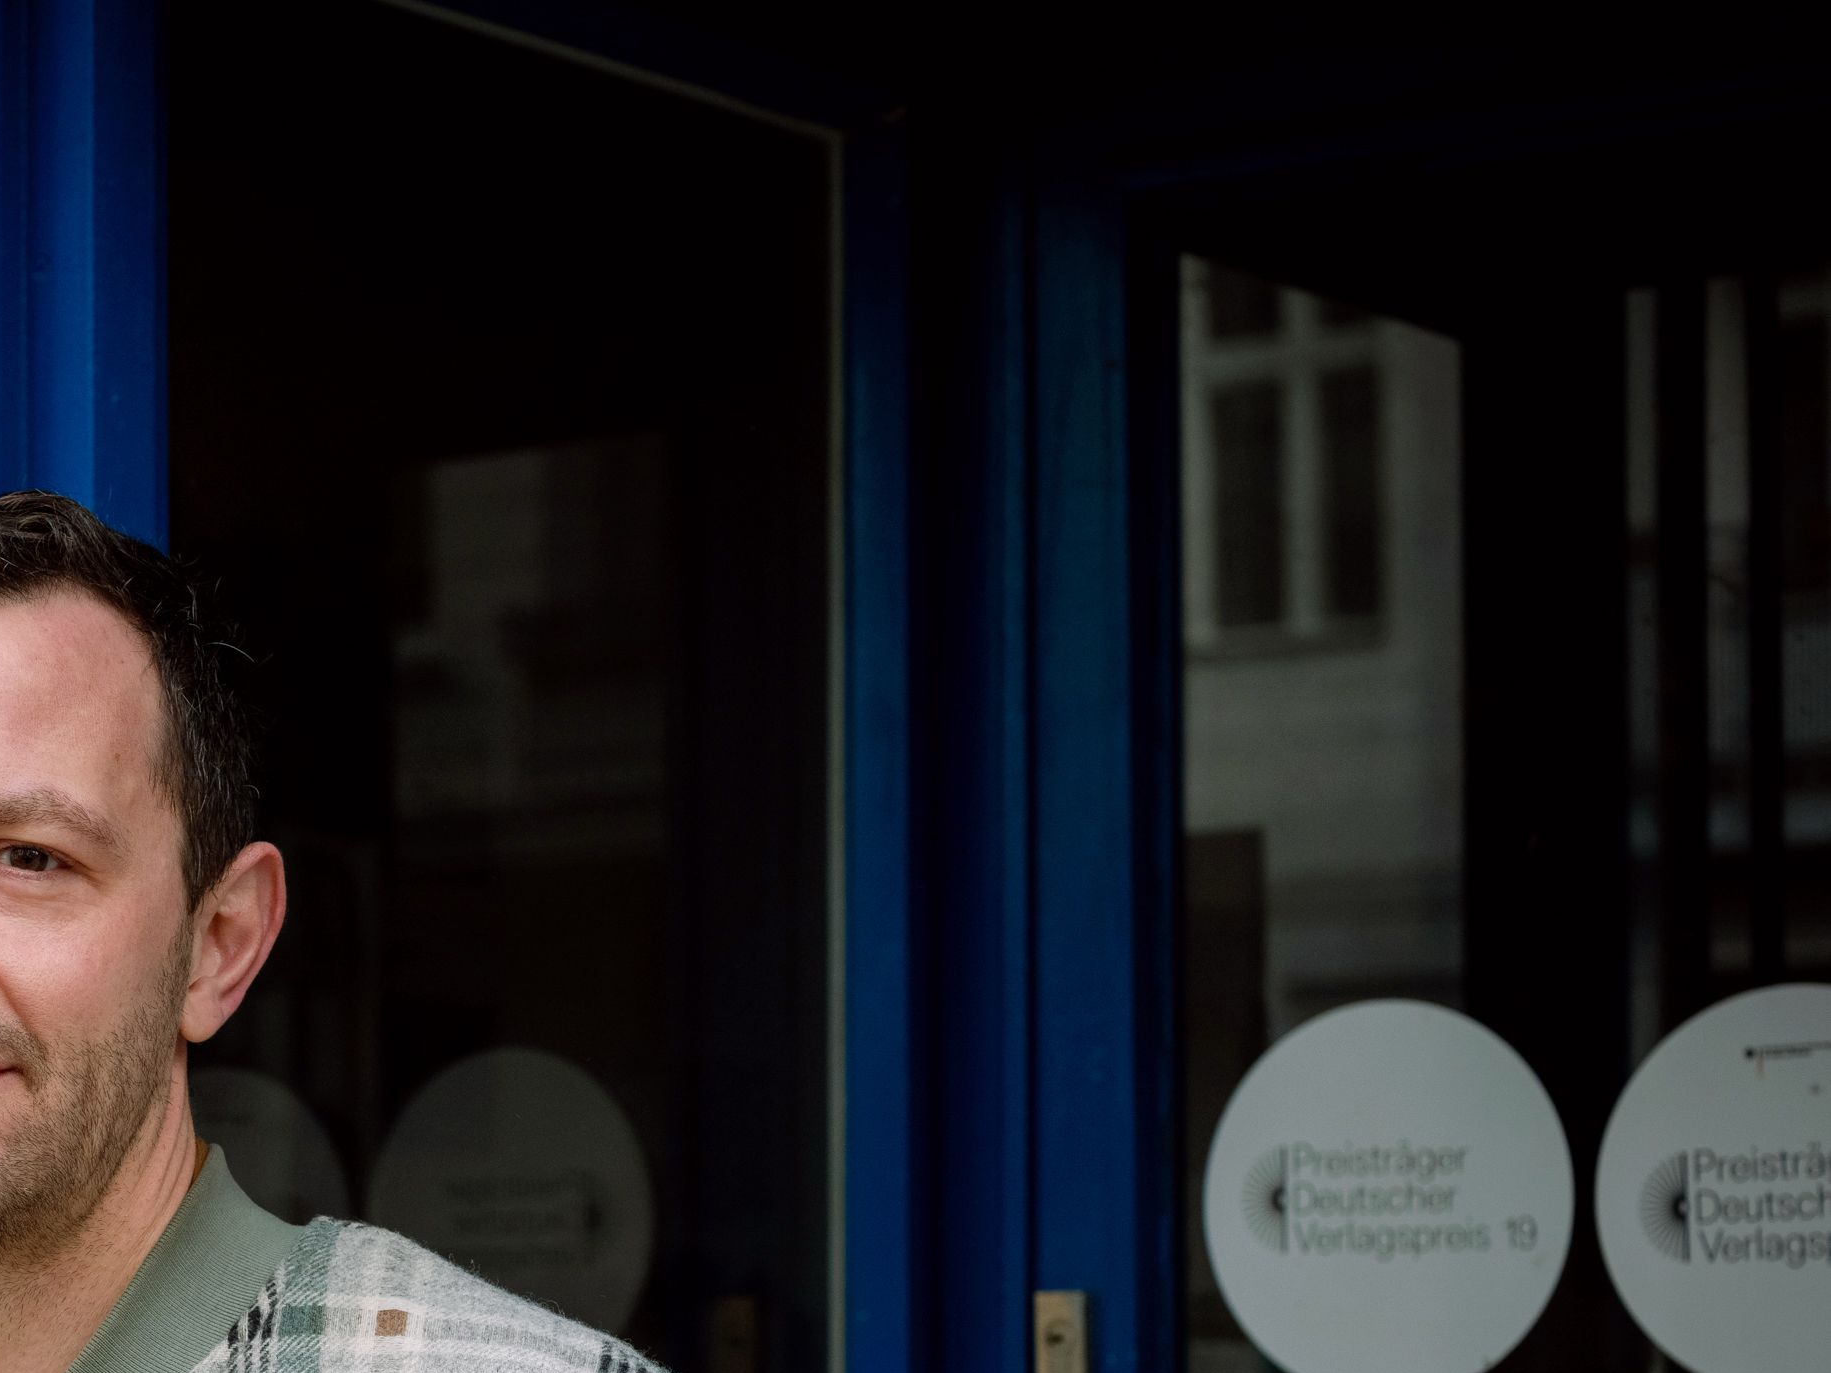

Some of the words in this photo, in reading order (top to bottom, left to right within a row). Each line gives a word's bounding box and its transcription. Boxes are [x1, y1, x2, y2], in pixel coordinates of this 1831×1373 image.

[1292, 1137, 1467, 1184] Preisträger
[1693, 1141, 1831, 1184] Preisträ
[1293, 1180, 1457, 1217] Deutscher
[1293, 1216, 1492, 1263] Verlagspreis
[1505, 1213, 1539, 1250] 19
[1697, 1224, 1831, 1270] Verlags
